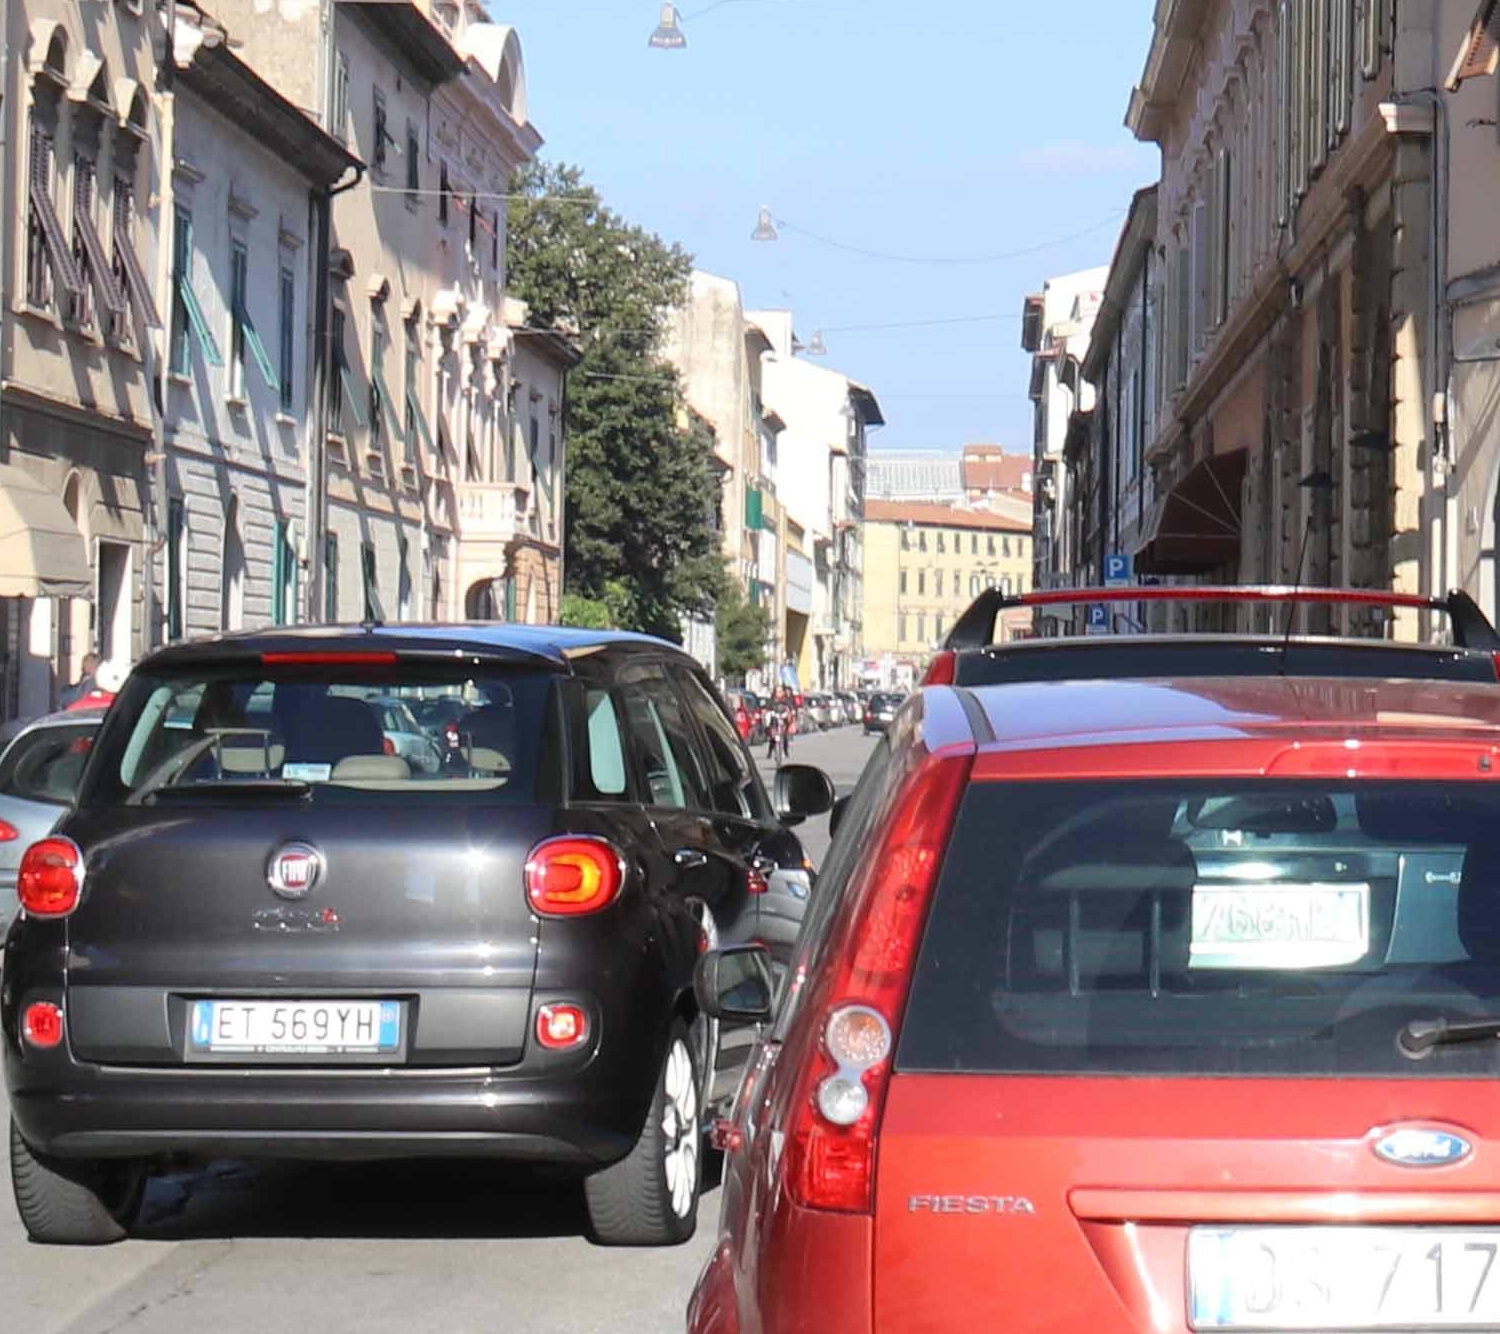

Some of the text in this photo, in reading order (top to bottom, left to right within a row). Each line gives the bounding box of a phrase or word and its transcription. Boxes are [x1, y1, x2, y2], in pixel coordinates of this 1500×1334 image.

[1109, 558, 1123, 577] P
[1091, 608, 1104, 624] P
[219, 1007, 374, 1041] ET 569YH
[908, 1194, 1036, 1214] FIESTA
